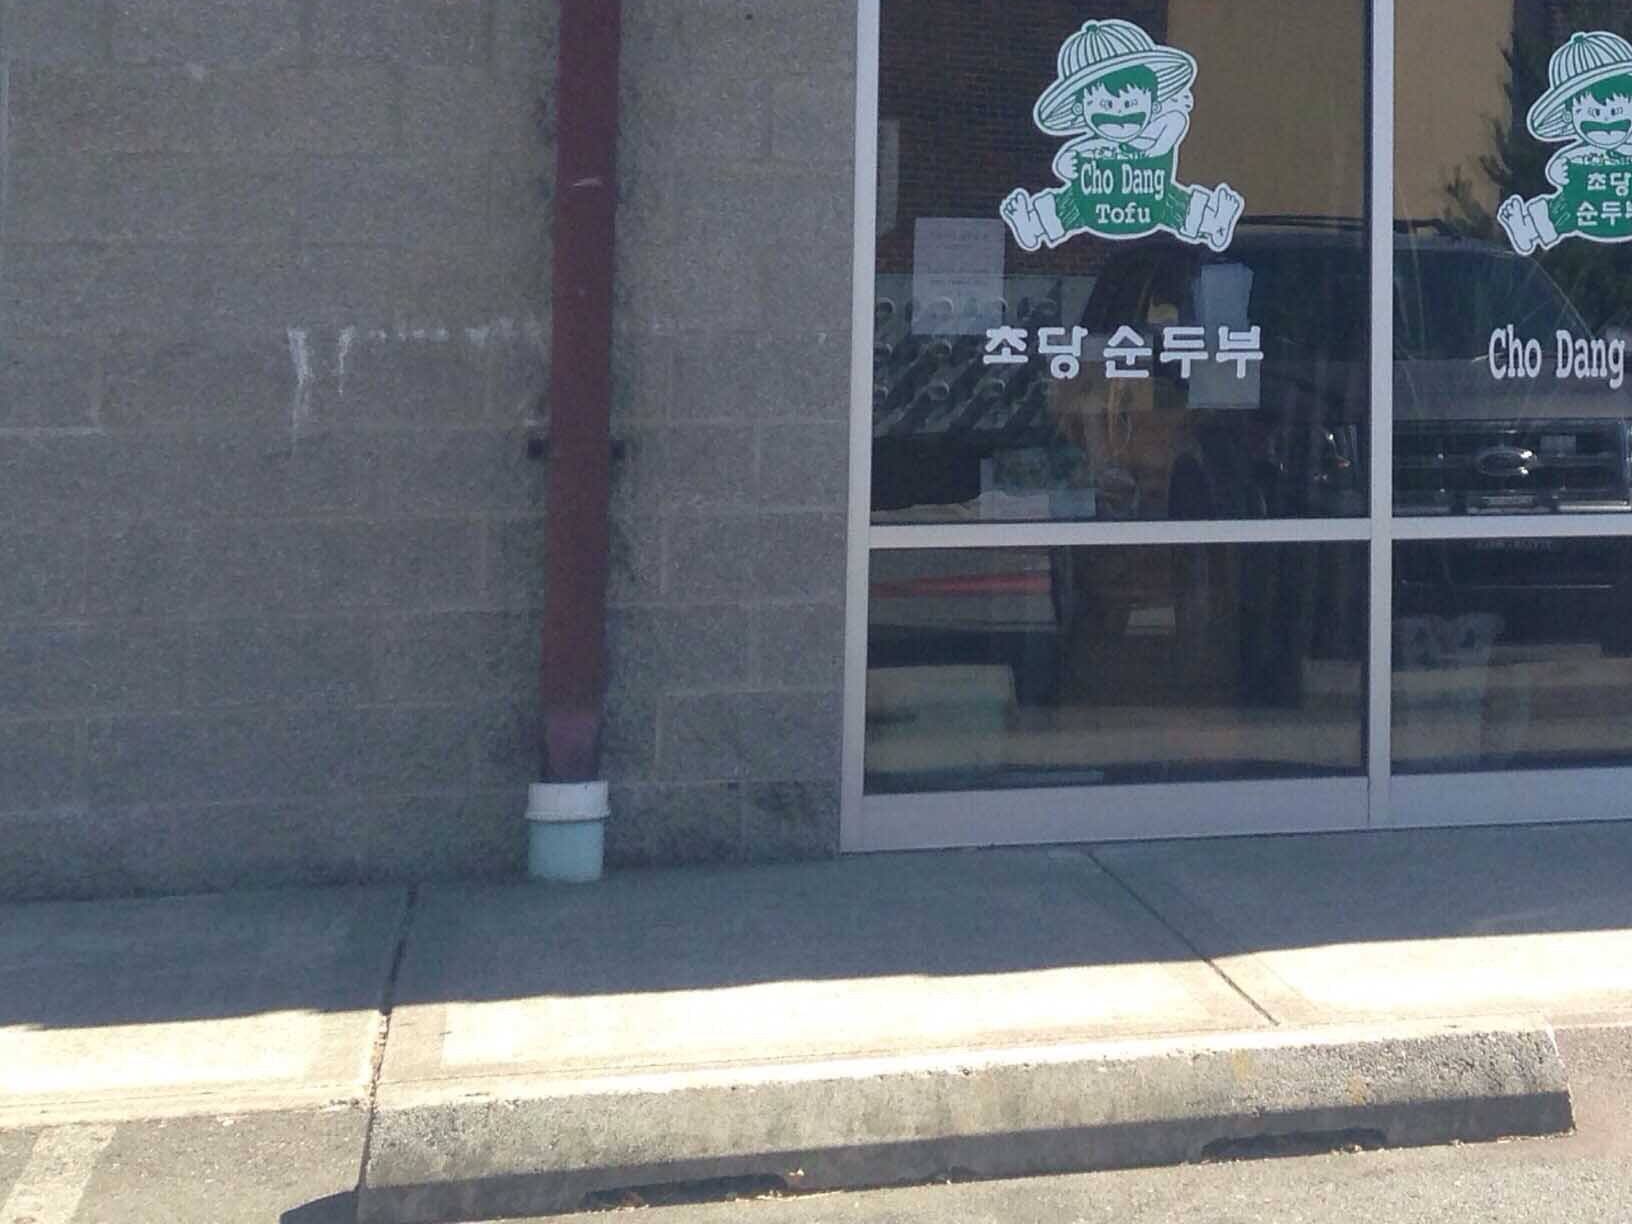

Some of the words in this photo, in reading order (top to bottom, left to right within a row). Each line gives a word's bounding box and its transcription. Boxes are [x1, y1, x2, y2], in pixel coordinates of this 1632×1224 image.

[1081, 160, 1114, 196] Cho
[1121, 163, 1166, 201] Dang
[1586, 172, 1632, 197] 초당
[1095, 201, 1152, 225] Tofu
[1488, 324, 1543, 380] Cho
[1555, 328, 1626, 388] Dang
